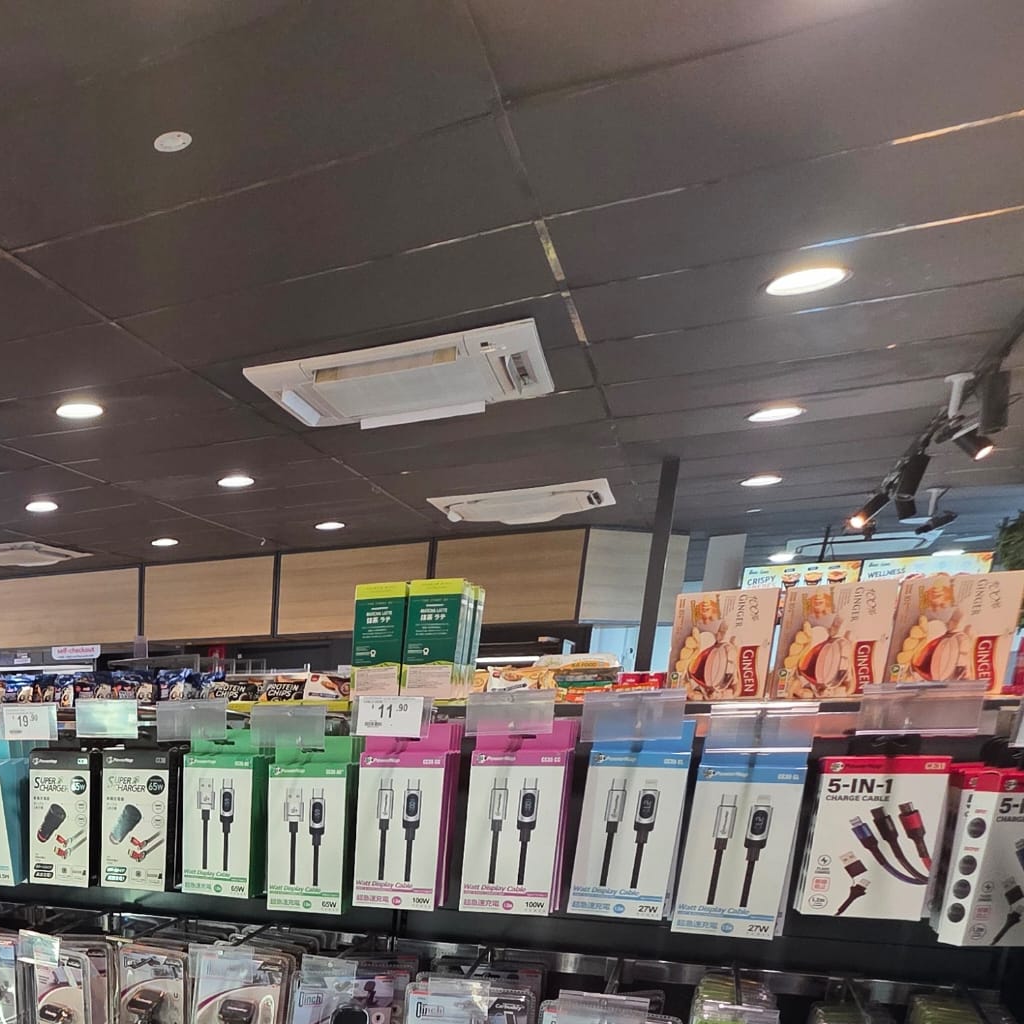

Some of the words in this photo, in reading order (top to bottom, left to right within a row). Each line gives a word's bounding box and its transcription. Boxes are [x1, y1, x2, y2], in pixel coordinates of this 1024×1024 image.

[868, 567, 906, 579] WELLNESS
[747, 575, 776, 586] CRISPY
[742, 649, 754, 692] GINGEN
[267, 690, 292, 698] CHIPS
[148, 782, 164, 791] 65W
[827, 778, 894, 793] 5-IN-1
[826, 794, 860, 802] CHARGE
[482, 884, 506, 892] Display
[594, 887, 617, 895] Display
[619, 888, 640, 896] Cable
[638, 905, 658, 913] 27W
[699, 905, 724, 913] Display
[726, 907, 749, 915] Cable
[748, 925, 769, 933] 27W
